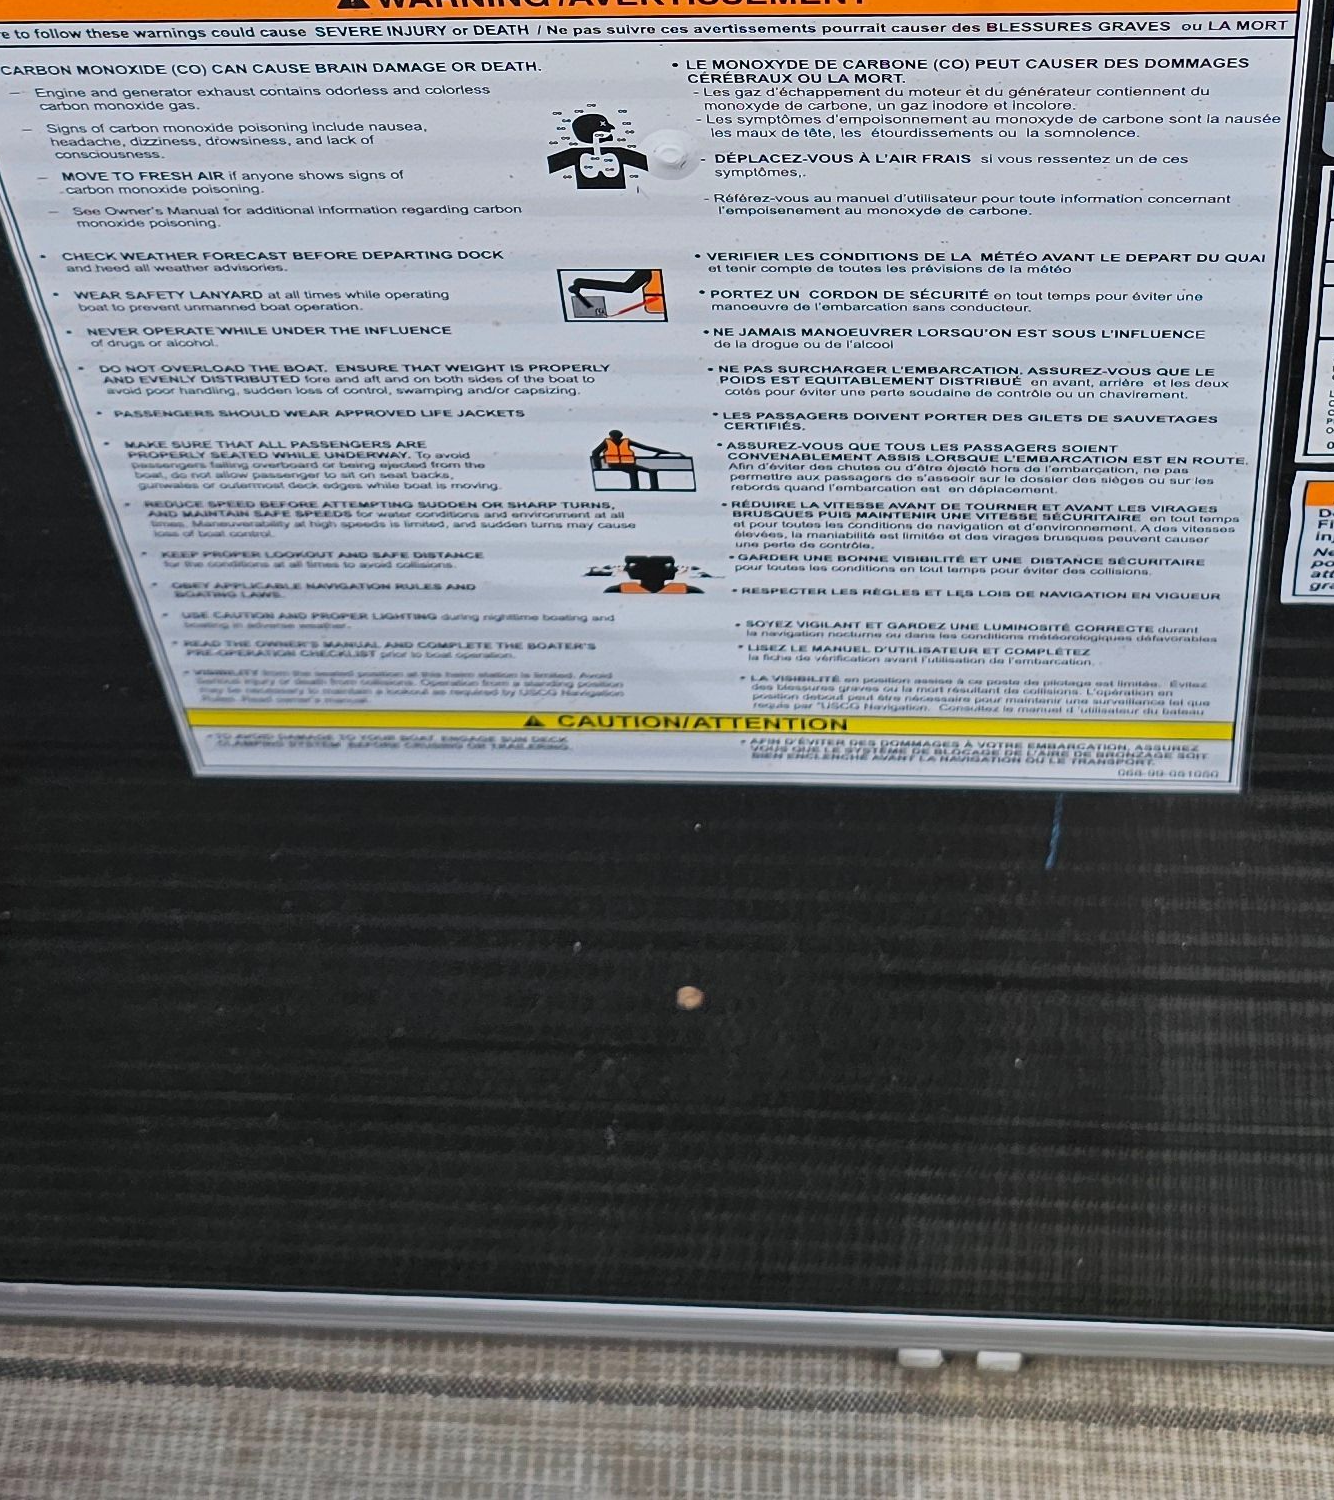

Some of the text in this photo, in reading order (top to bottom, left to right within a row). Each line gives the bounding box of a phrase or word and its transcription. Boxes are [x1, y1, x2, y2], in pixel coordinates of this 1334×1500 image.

[0, 61, 542, 77] CARBON MONOXIDE (CO) CAN CAUSE BRAIN DAMAGE OR DEATH.
[558, 714, 848, 731] CAUTION/ATTENTION
